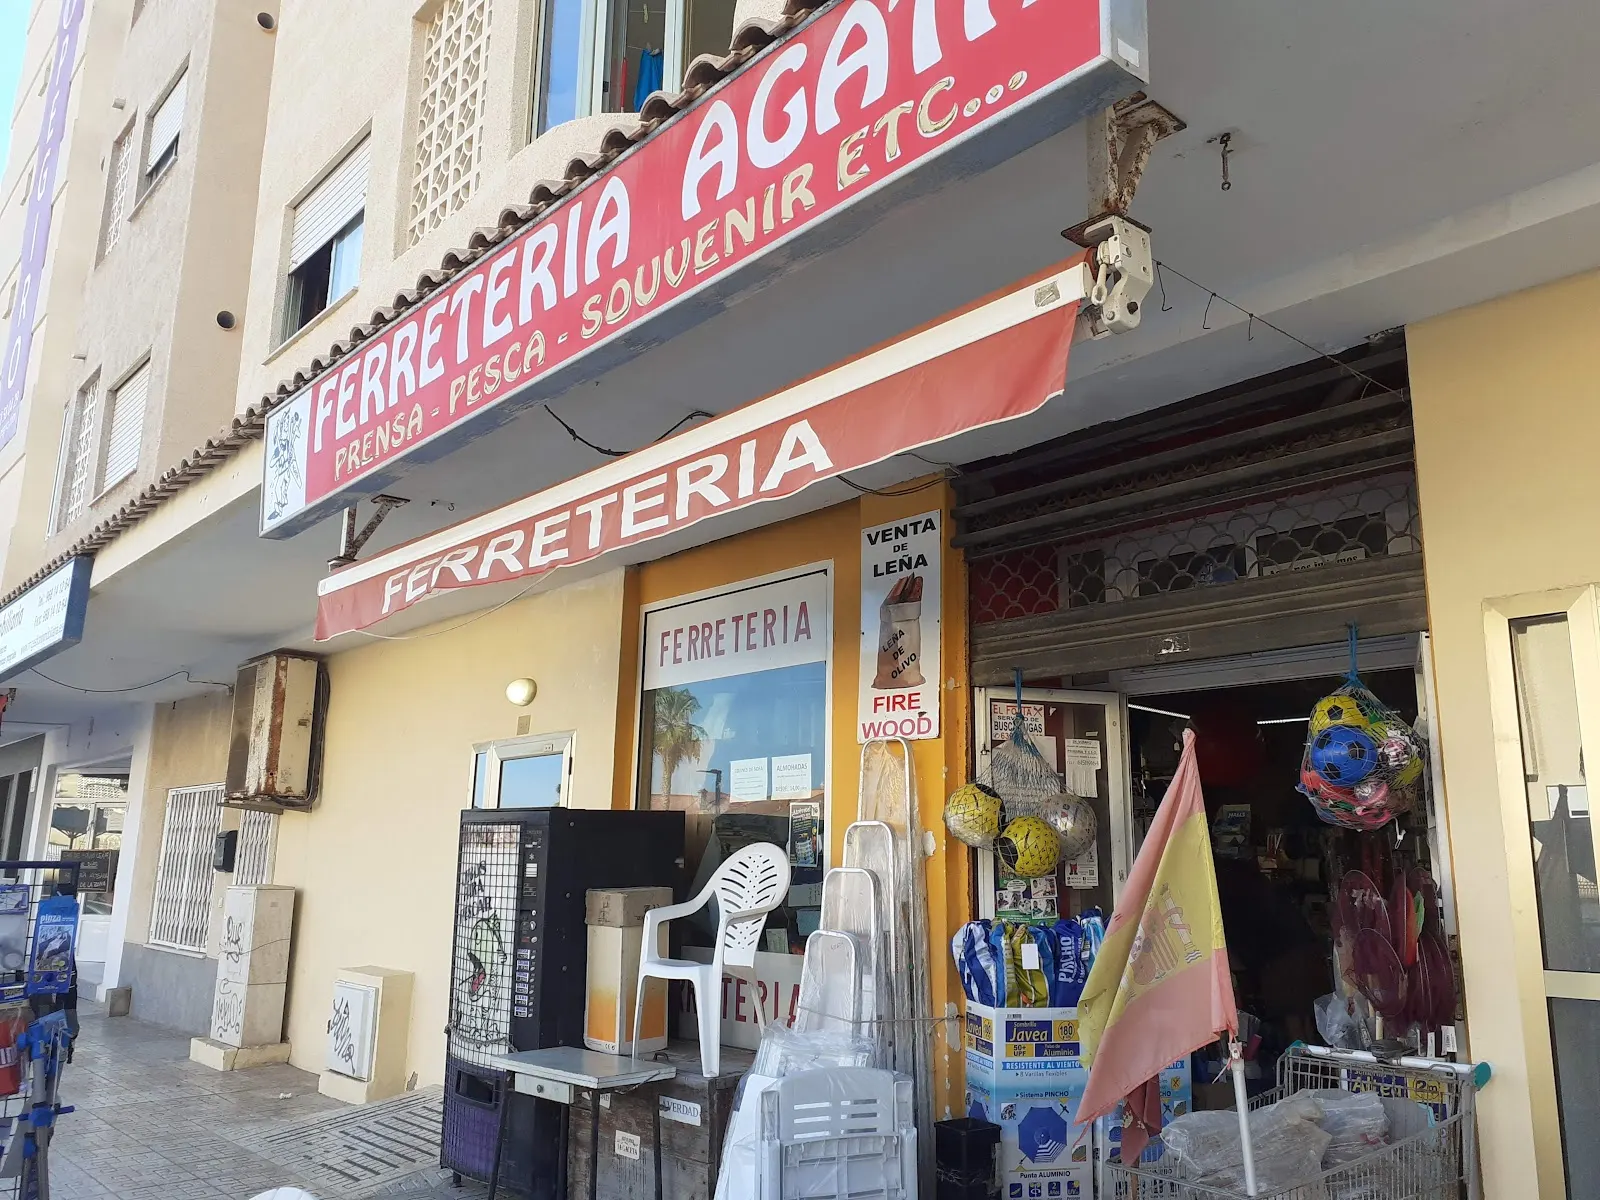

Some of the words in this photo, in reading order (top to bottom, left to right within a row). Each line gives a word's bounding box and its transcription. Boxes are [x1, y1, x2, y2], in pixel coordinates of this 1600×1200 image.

[334, 403, 424, 481] PRENSA
[449, 330, 546, 417] PESCA
[580, 162, 816, 340] SOUVENIR
[836, 70, 1028, 192] ETC...
[313, 174, 631, 454] FERRETERIA
[381, 418, 836, 615] FERRETERIA
[866, 516, 937, 546] VENTA
[892, 542, 909, 554] DE
[873, 554, 929, 578] LEÑA
[659, 601, 812, 667] FERRETERIA
[882, 629, 906, 653] LEÑA
[892, 646, 905, 662] DE
[890, 652, 918, 681] OLIVO
[873, 692, 921, 714] FIRE
[993, 704, 1003, 715] EL
[861, 715, 933, 739] WOOD
[1009, 1027, 1048, 1042] Javea
[1060, 1024, 1075, 1036] 180
[1043, 1048, 1074, 1056] Aluminio
[1006, 1062, 1044, 1070] RESISTENTE
[1046, 1061, 1055, 1069] AL
[1055, 1060, 1080, 1069] VIENTO
[668, 1102, 699, 1118] VERDAD
